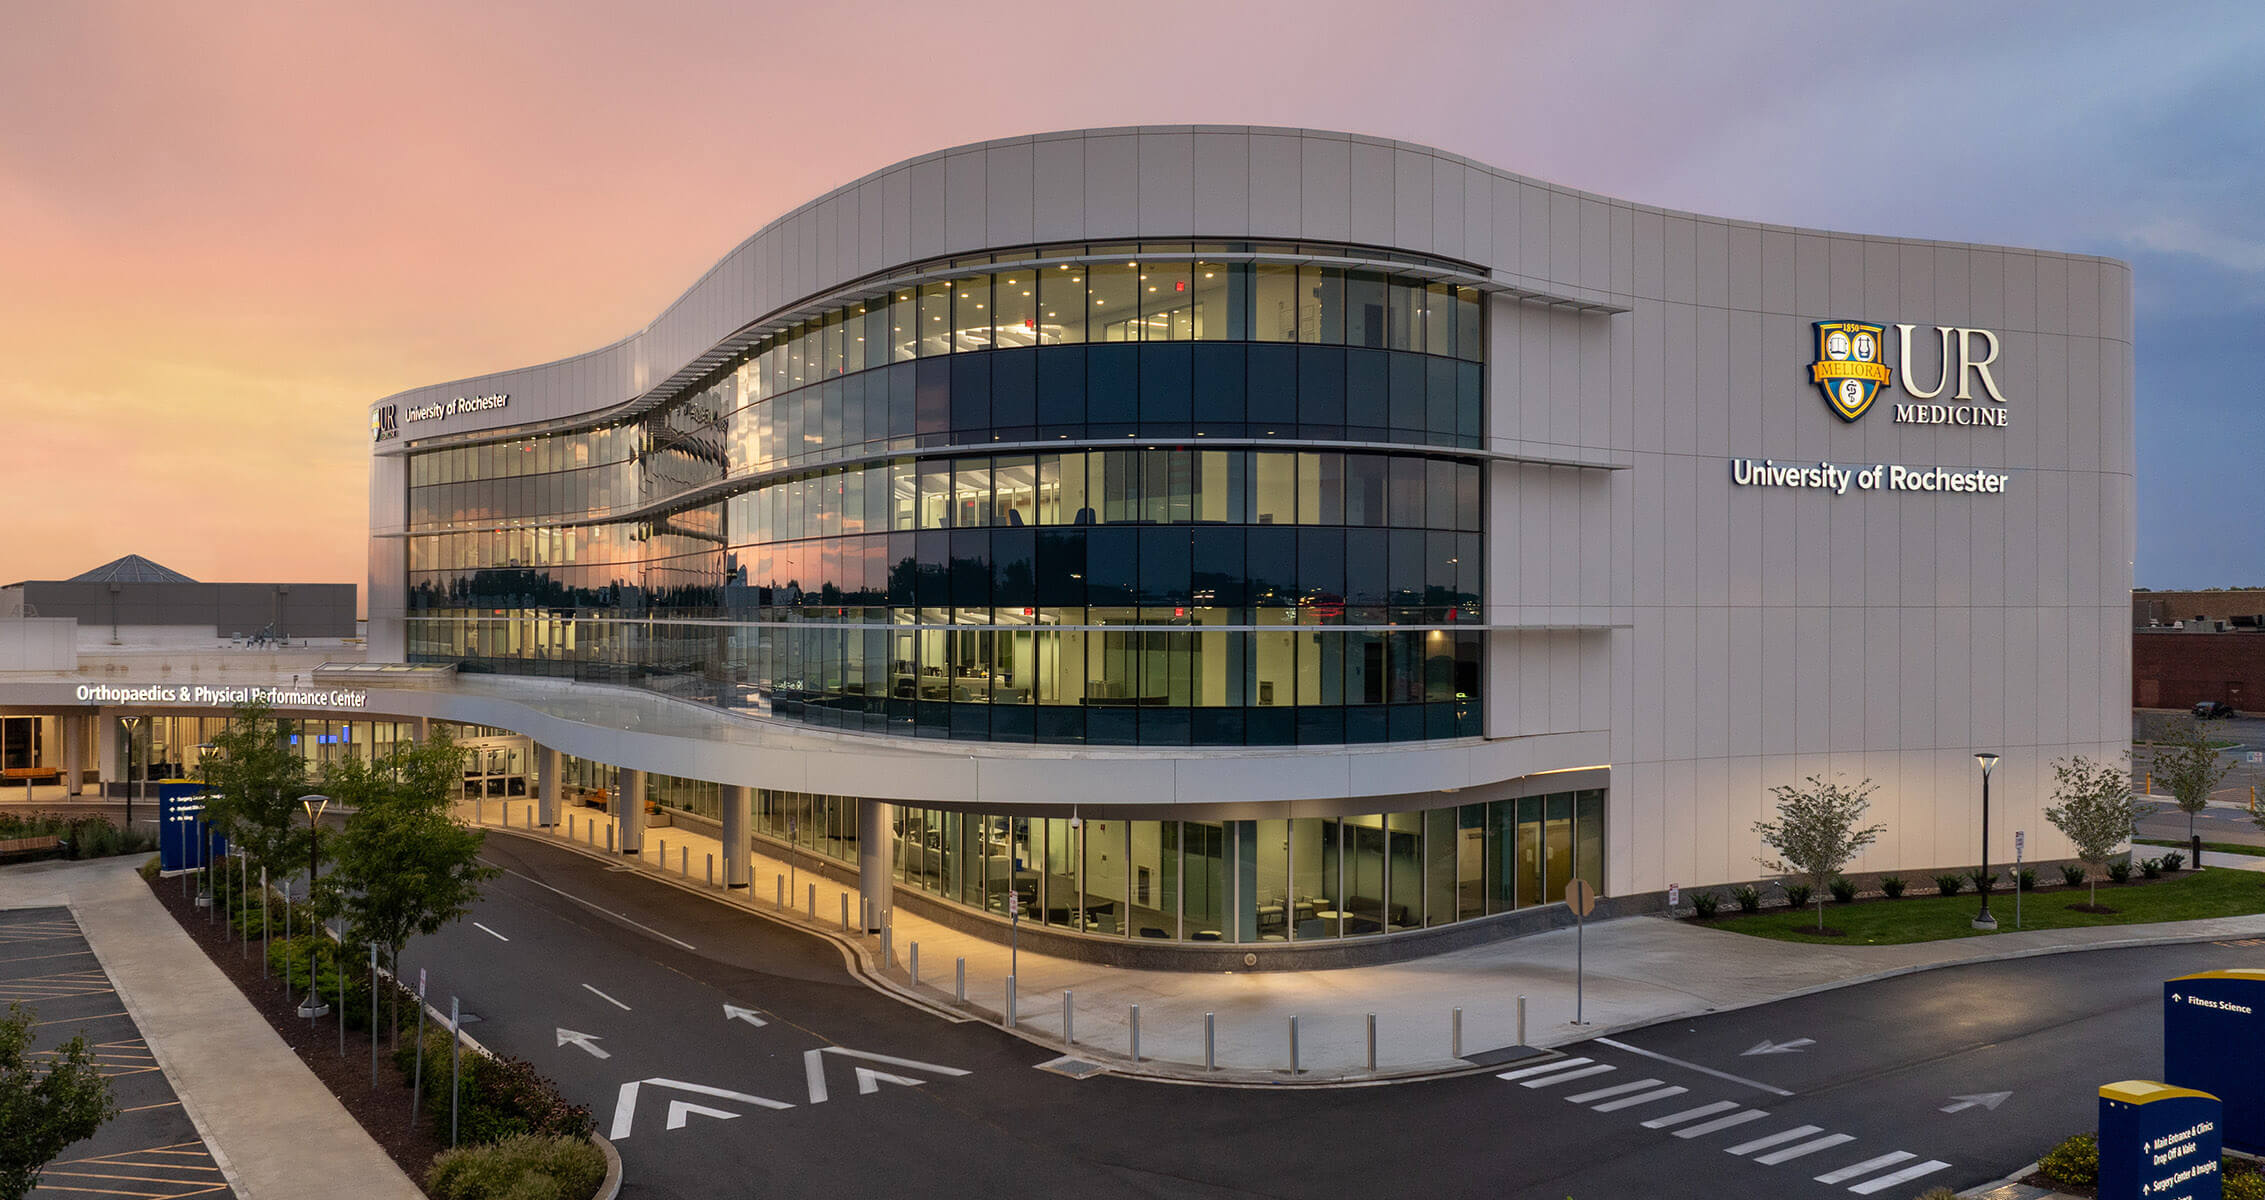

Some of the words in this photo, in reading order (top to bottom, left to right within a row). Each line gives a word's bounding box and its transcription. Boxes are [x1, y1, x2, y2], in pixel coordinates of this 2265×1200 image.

[1842, 323, 1861, 333] 1850
[1821, 362, 1882, 379] MELIORA
[1895, 323, 2008, 403] UR
[405, 402, 446, 423] University
[446, 399, 458, 415] of
[458, 393, 509, 413] Rochester
[1894, 403, 2009, 427] MEDICINE
[1732, 459, 1852, 495] University
[1857, 464, 1884, 490] of
[1888, 465, 2009, 493] Rochester
[76, 684, 177, 705] Orthopaedics
[179, 685, 192, 702] &
[195, 686, 249, 707] Physical
[251, 687, 330, 706] Performance
[330, 688, 368, 708] Center
[2188, 995, 2218, 1009] Fitness
[2219, 1000, 2252, 1015] Science
[2153, 1136, 2168, 1151] Main
[2168, 1128, 2192, 1145] Entrance
[2191, 1125, 2197, 1137] &
[2196, 1120, 2214, 1135] Clinics
[2153, 1153, 2168, 1166] Drop
[2167, 1146, 2177, 1161] Off
[2177, 1145, 2182, 1157] &
[2182, 1141, 2197, 1155] Valet
[2152, 1176, 2174, 1192] Surgery
[2173, 1170, 2192, 1184] Center
[2191, 1165, 2197, 1177] &
[2196, 1160, 2217, 1175] Imaging
